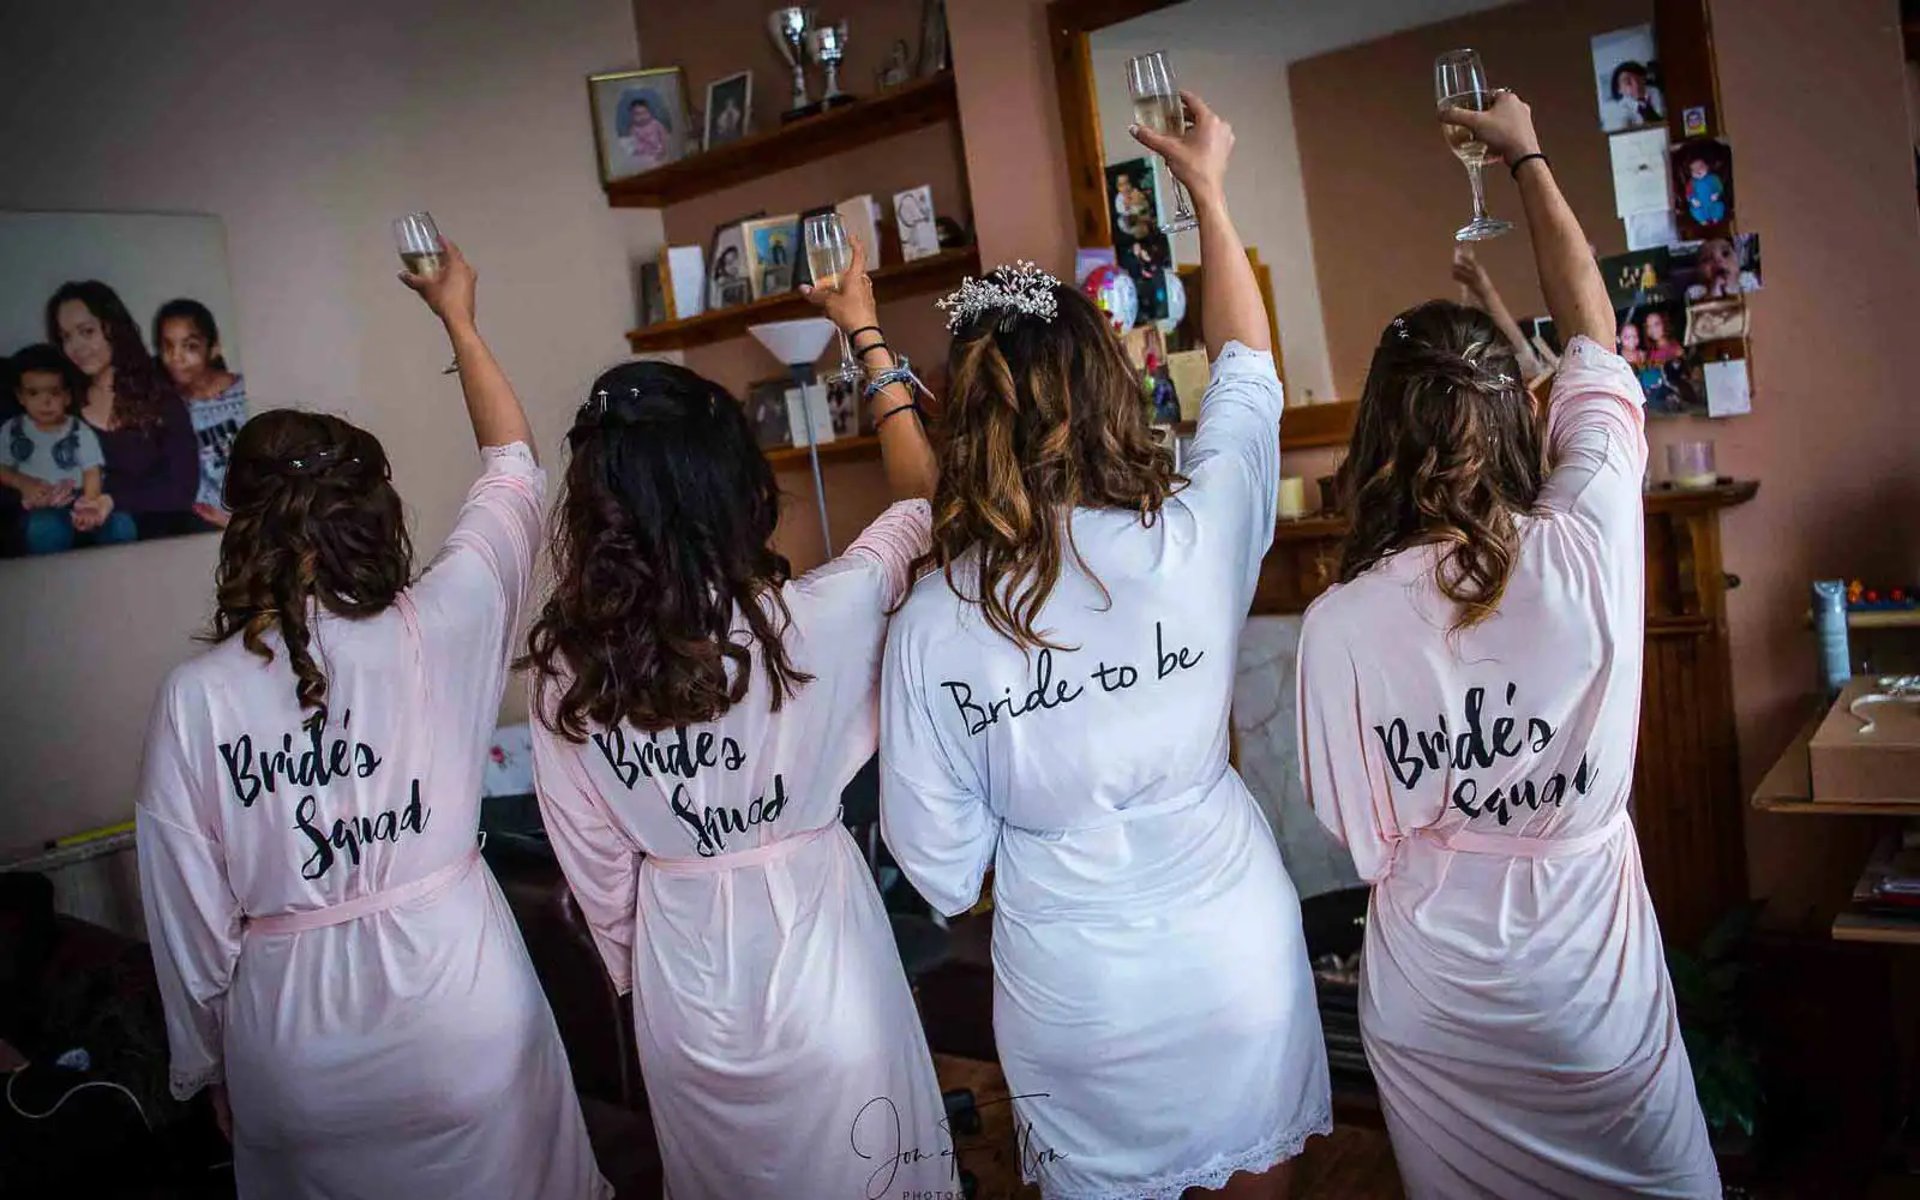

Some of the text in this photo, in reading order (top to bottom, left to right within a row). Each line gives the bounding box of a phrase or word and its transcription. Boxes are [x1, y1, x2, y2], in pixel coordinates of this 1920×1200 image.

[941, 621, 1204, 737] Bride to be
[218, 708, 382, 807] Bride's
[1373, 682, 1558, 790] Bride's
[293, 778, 431, 880] Squad
[671, 774, 788, 858] Squad
